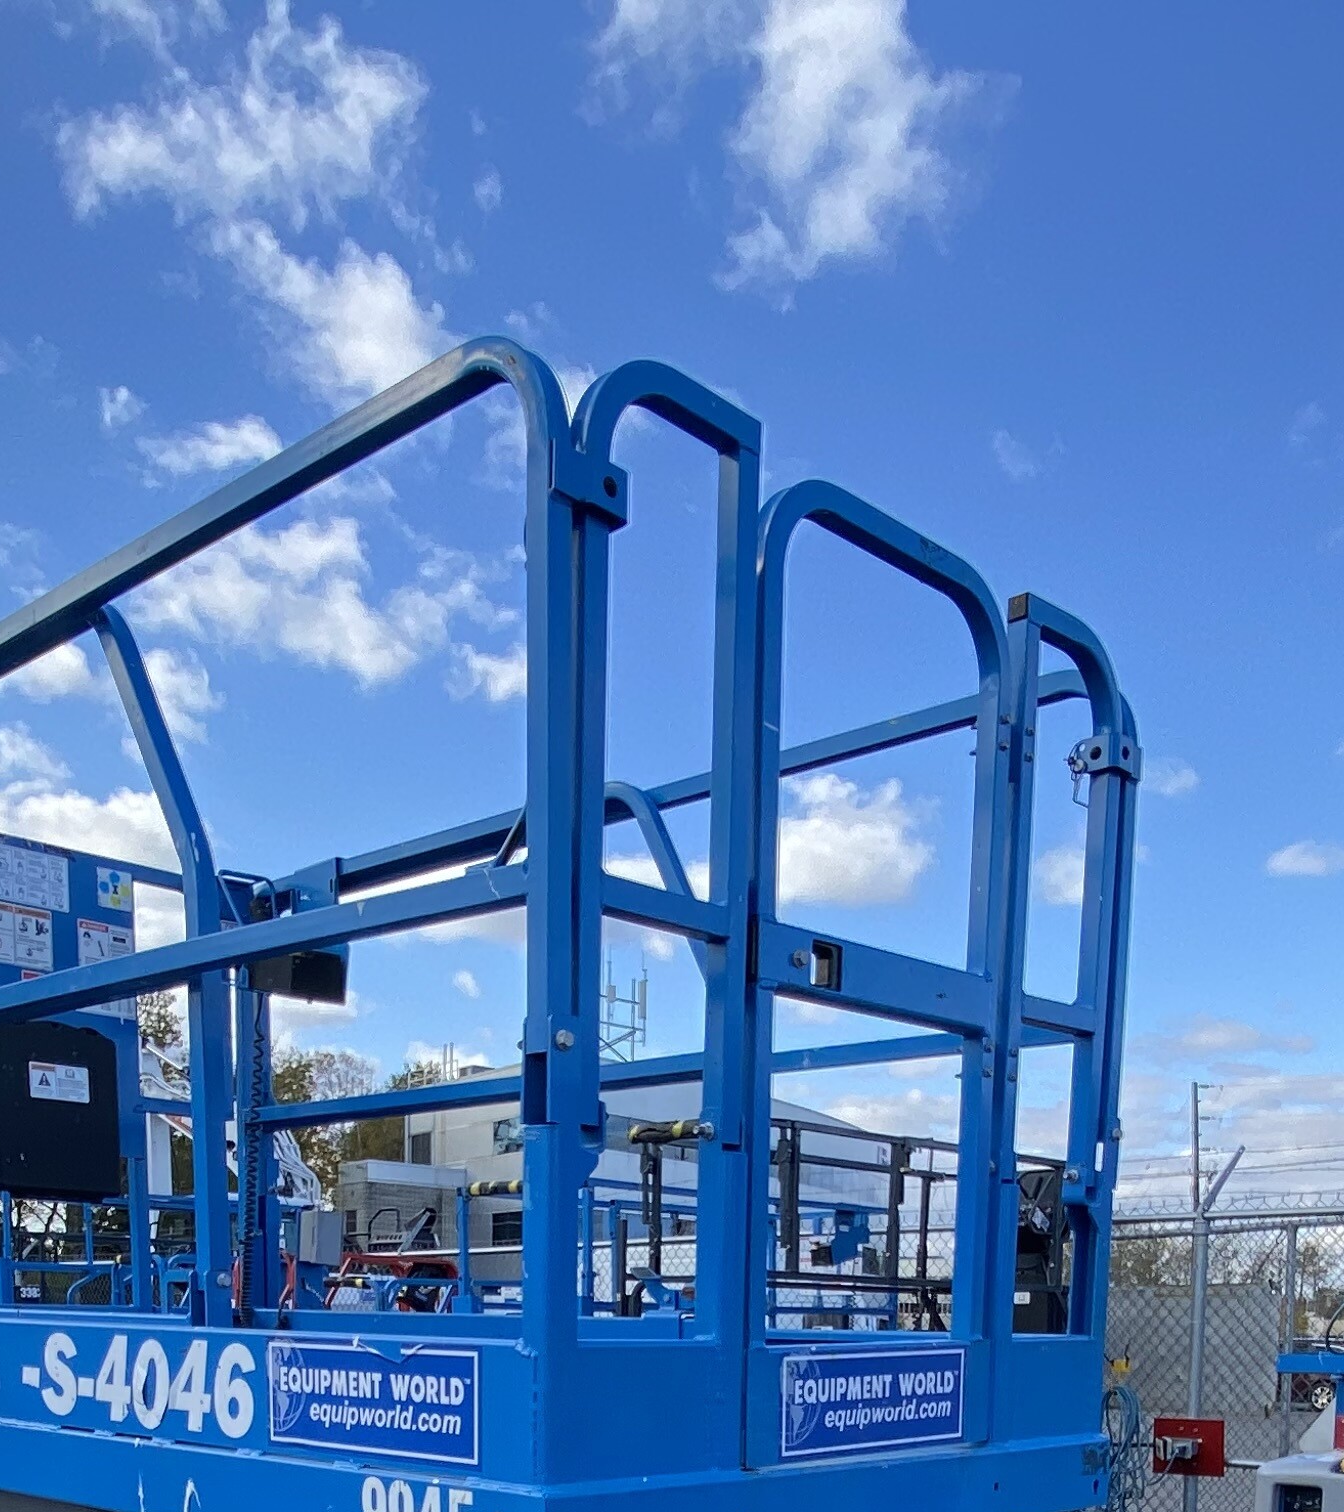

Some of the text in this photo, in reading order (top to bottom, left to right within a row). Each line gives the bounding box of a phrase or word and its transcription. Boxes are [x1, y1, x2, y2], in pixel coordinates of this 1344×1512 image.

[279, 1366, 466, 1406] EQUIPMENT WORLD
[794, 1371, 955, 1404] EQUIPMENT WORLD
[309, 1400, 461, 1435] equipworld.com
[824, 1399, 951, 1431] equipworld.com
